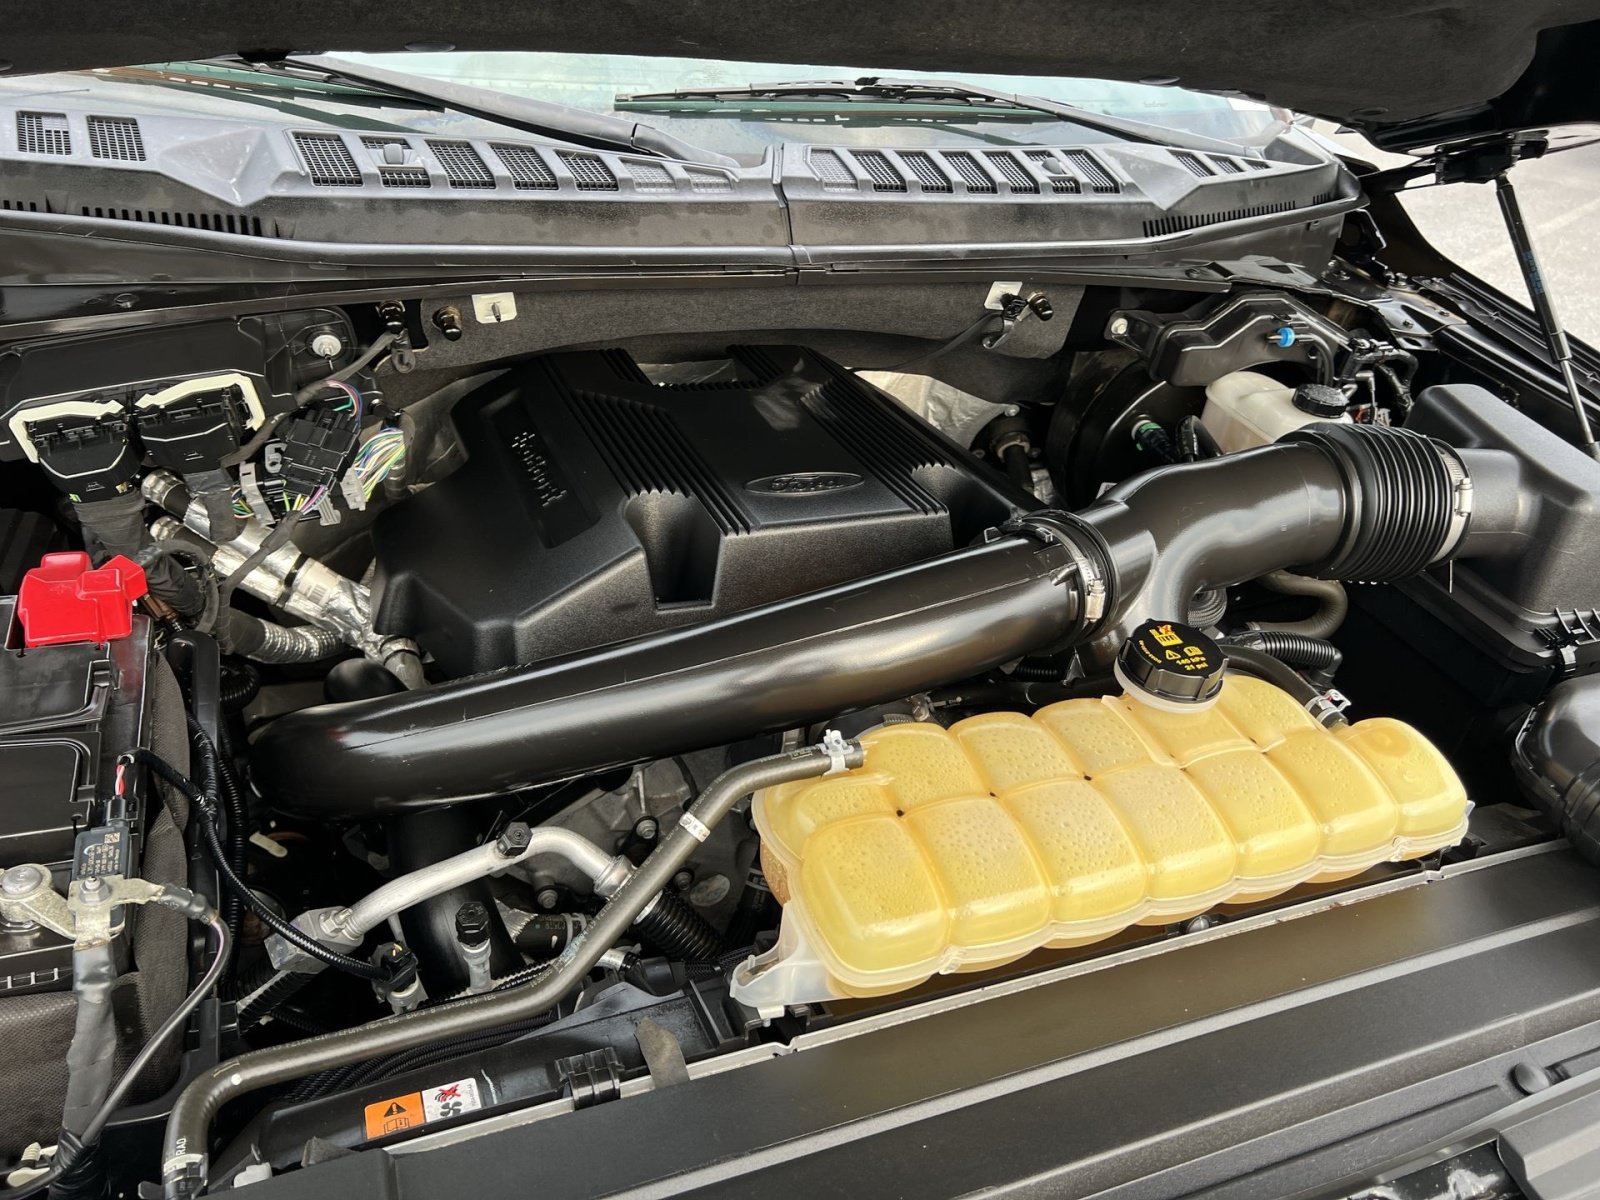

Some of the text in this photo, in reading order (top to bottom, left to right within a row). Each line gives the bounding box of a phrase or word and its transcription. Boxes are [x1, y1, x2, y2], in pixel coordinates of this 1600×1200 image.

[768, 474, 845, 494] Ford
[1195, 662, 1209, 670] psi
[175, 1137, 187, 1156] RAD
